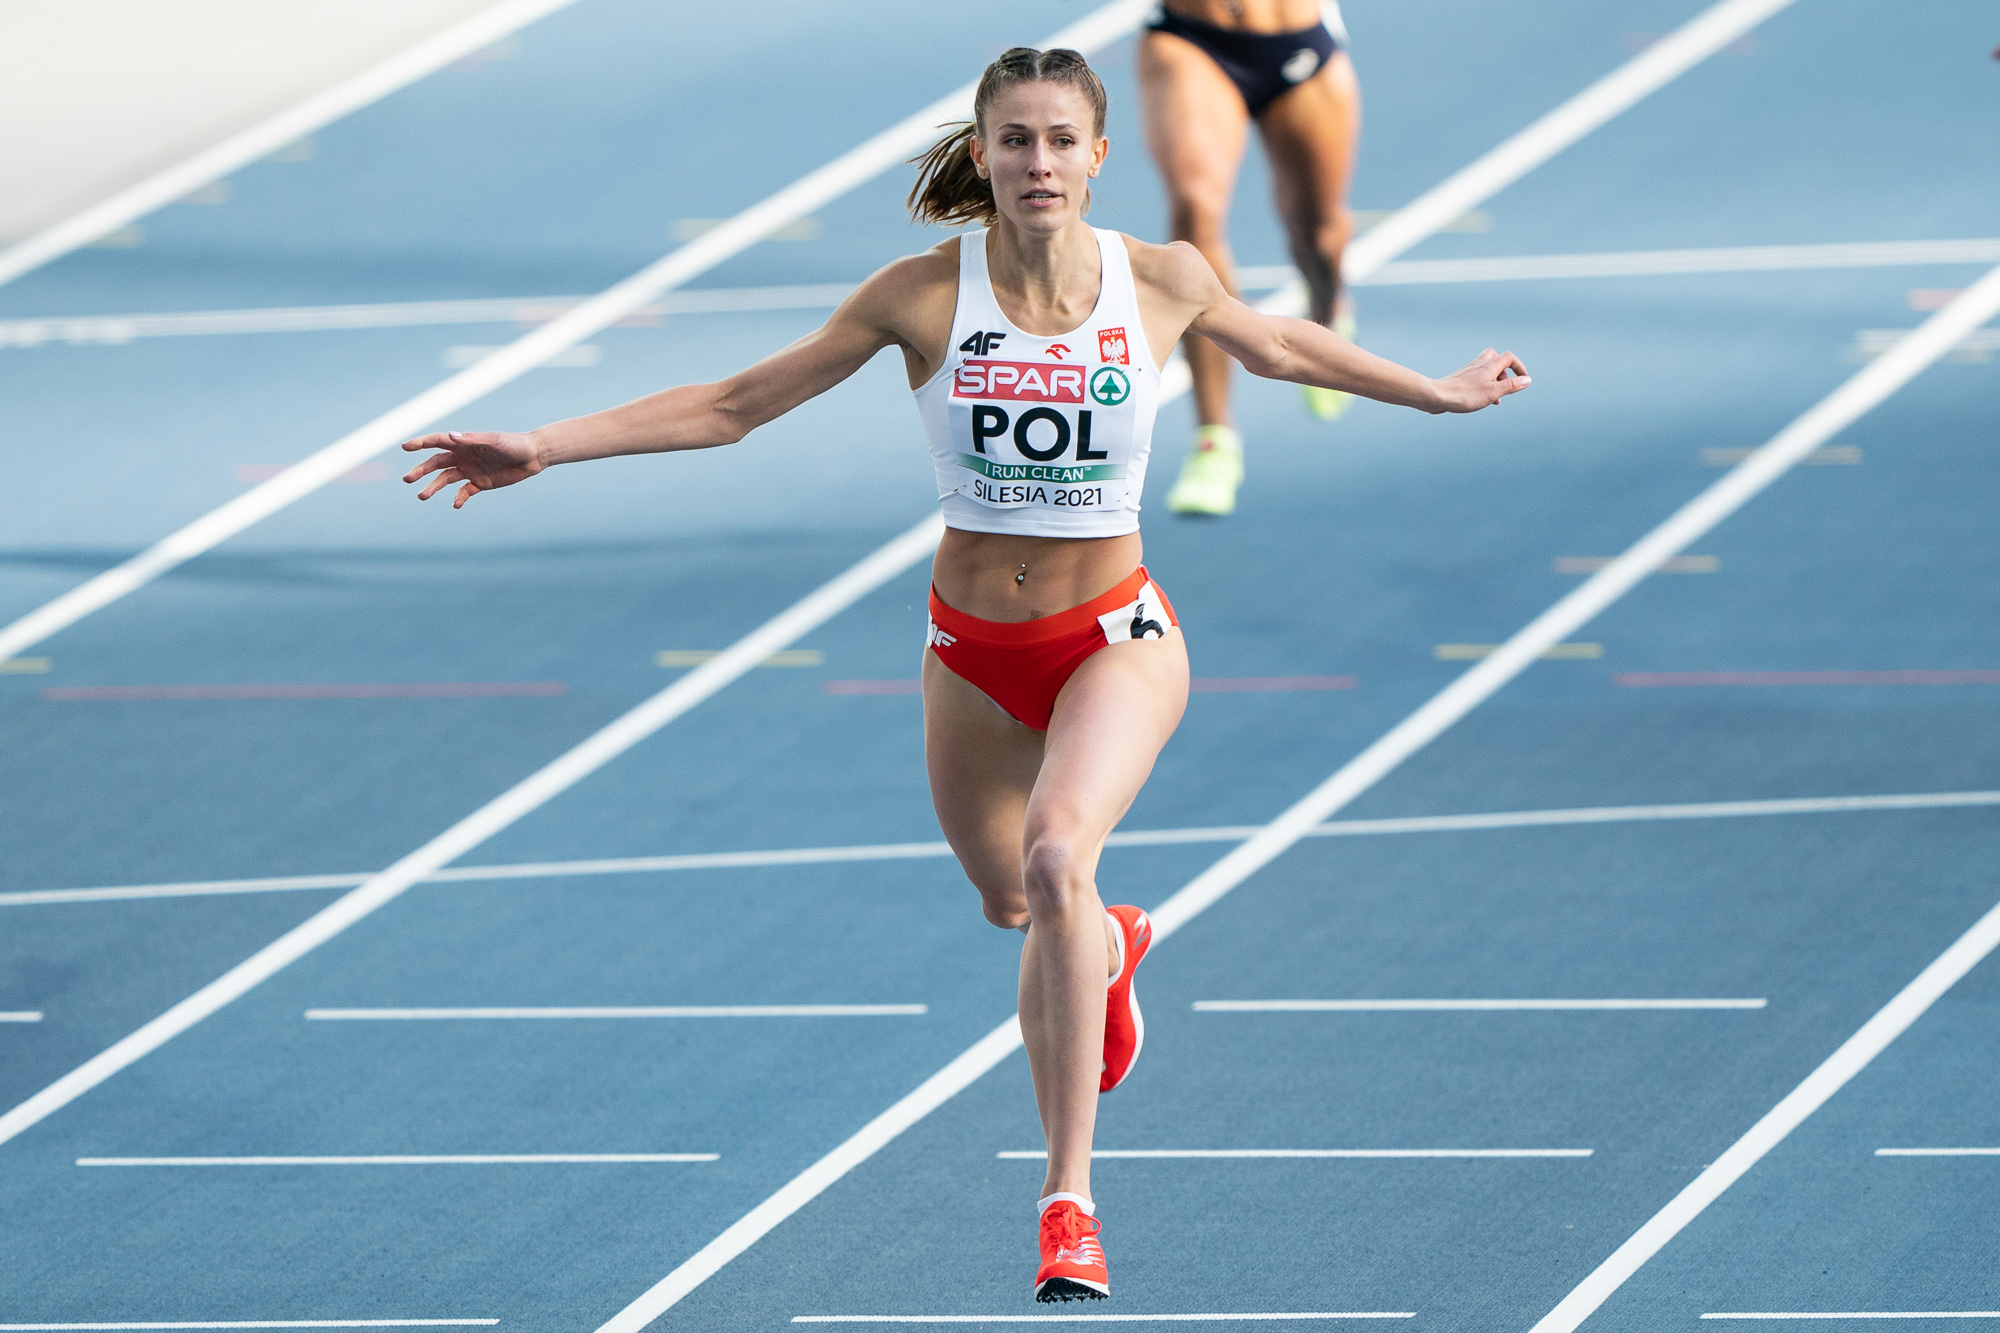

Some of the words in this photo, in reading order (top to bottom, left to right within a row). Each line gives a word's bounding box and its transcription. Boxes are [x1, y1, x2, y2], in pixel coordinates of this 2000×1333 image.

[959, 331, 1006, 356] 4F
[1100, 329, 1124, 337] POLSKA
[957, 365, 1082, 398] SPAR
[972, 404, 1108, 462] POL
[985, 462, 989, 474] I
[992, 465, 1026, 479] RUN
[974, 479, 1048, 504] SILESIA
[1054, 487, 1102, 507] 2021
